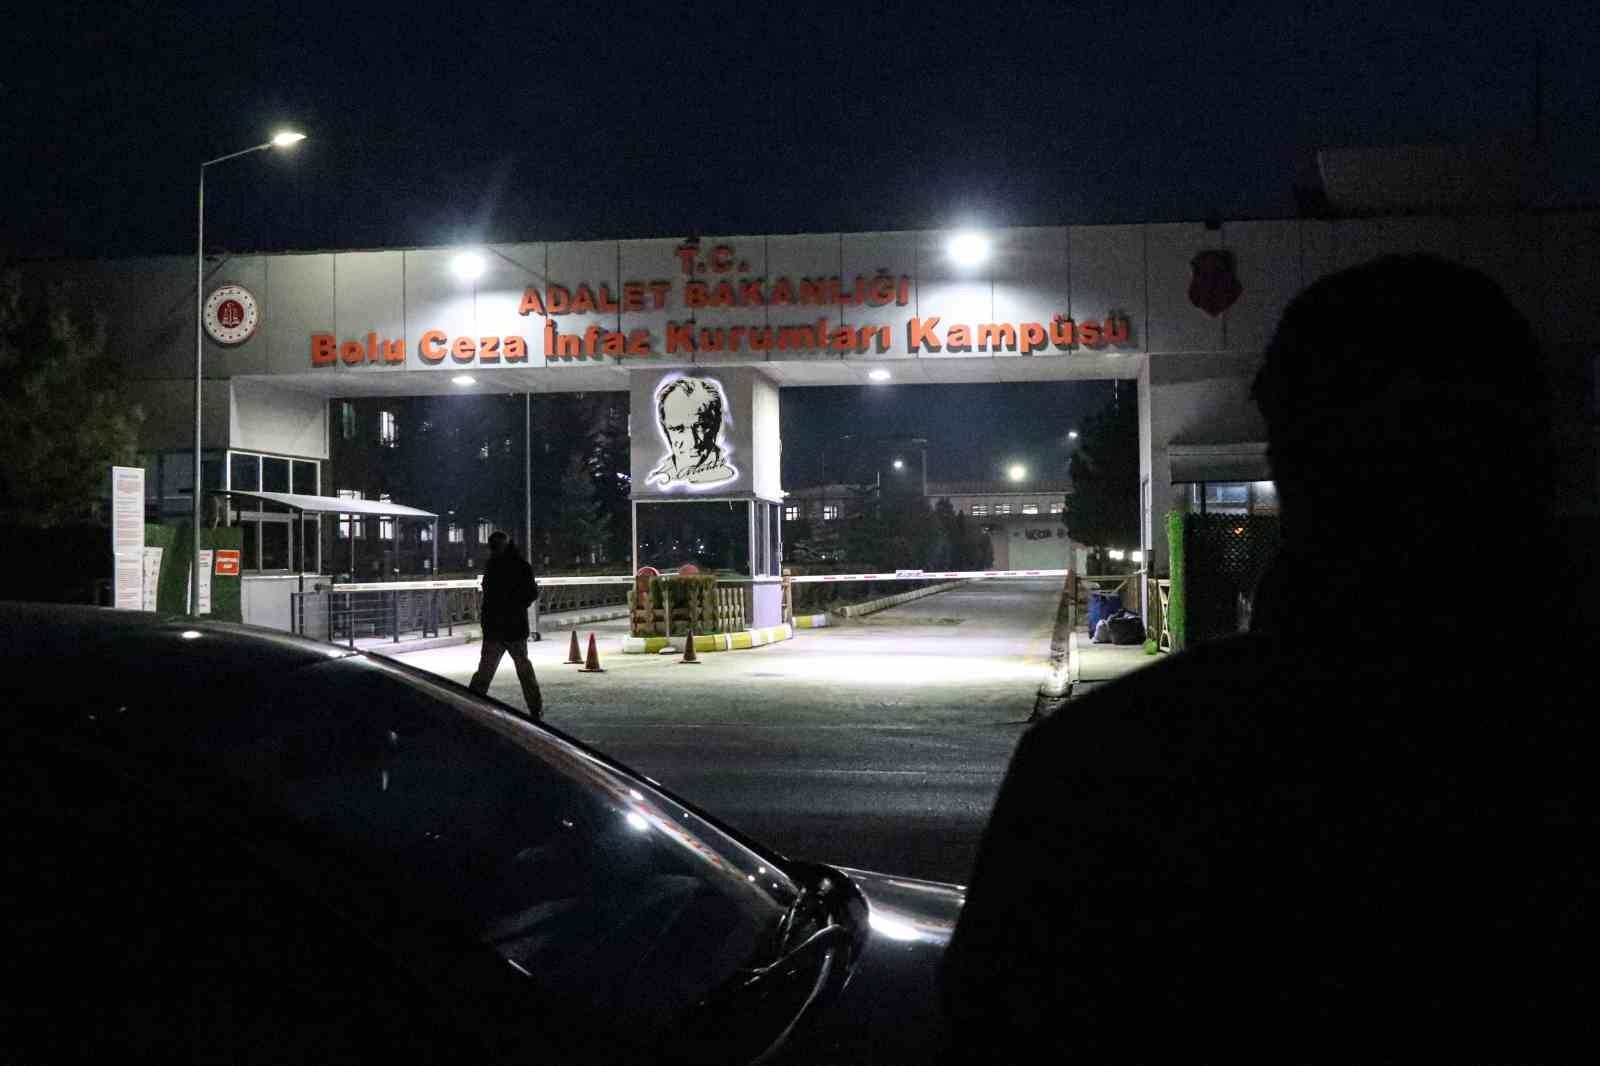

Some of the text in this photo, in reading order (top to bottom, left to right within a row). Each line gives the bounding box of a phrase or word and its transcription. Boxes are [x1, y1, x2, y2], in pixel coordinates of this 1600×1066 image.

[675, 244, 748, 275] T.C.
[518, 267, 910, 316] ADALET BAKANLIĞI
[310, 309, 1131, 363] Bolu Ceza İnfaz Kurumları Kampüsü
